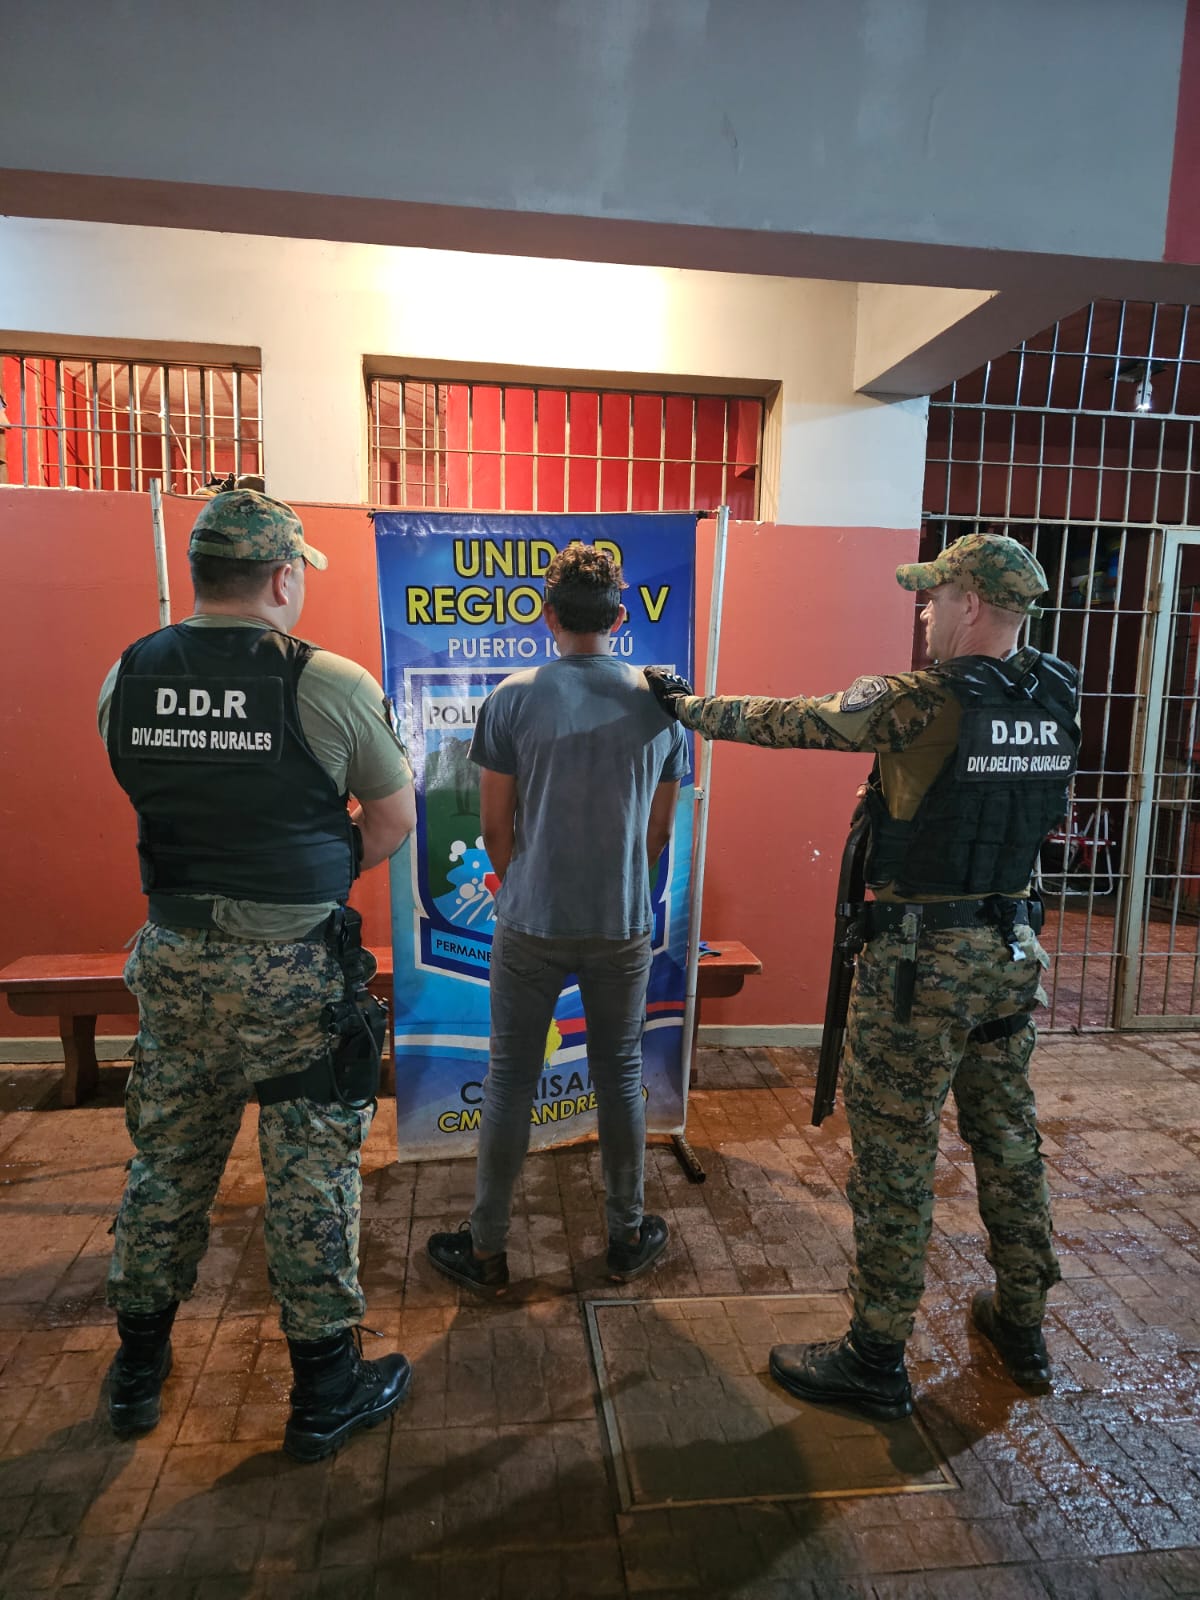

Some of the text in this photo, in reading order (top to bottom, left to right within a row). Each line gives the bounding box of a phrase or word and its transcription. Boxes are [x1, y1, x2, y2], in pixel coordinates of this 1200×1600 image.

[453, 539, 623, 578] UNIDD
[406, 585, 670, 625] REGIO V
[448, 631, 633, 658] PUERTO IZÚ
[155, 687, 248, 719] D.D.R
[429, 705, 482, 724] POLI
[131, 727, 272, 751] DIV.DELITOS RURALES
[991, 719, 1059, 746] D.D.R
[1030, 754, 1071, 772] RURALES
[436, 938, 492, 963] PERMANE
